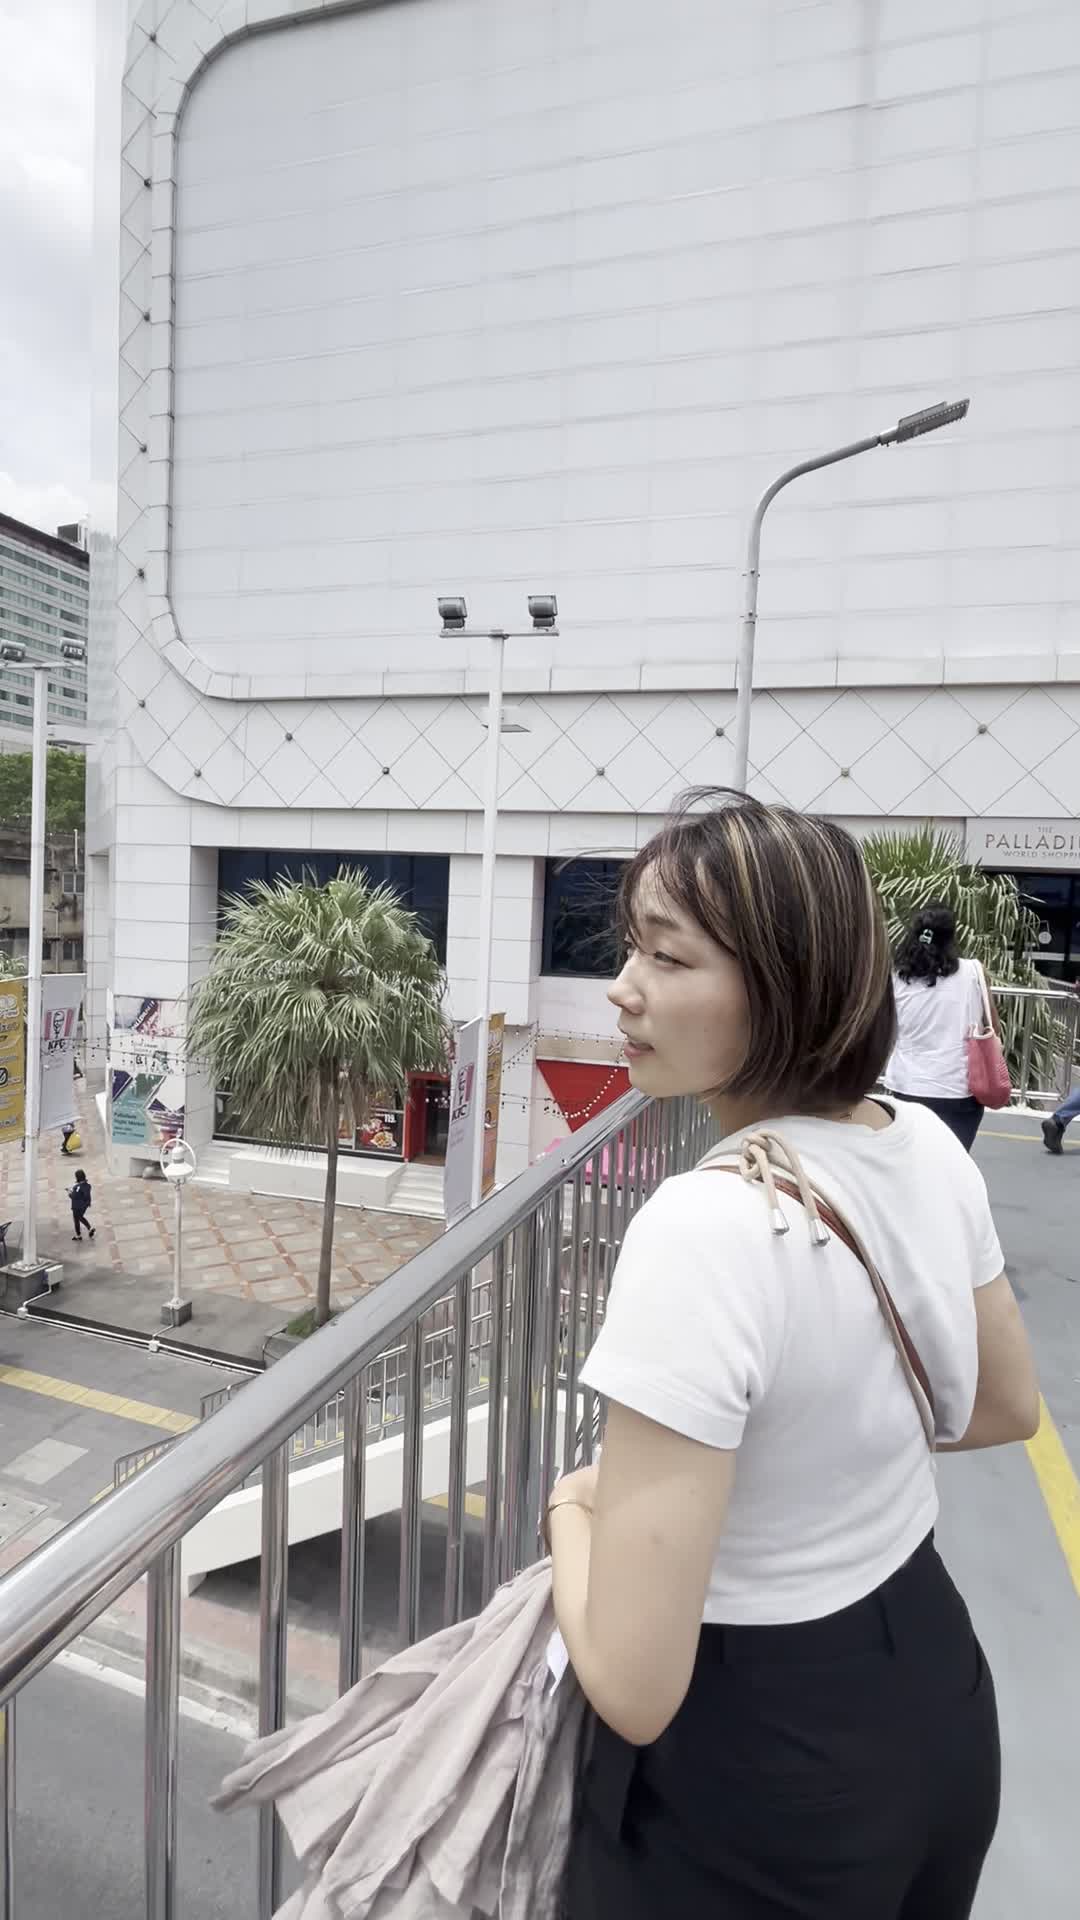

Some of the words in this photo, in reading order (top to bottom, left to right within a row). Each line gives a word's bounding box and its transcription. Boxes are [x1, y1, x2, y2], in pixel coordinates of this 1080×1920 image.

[985, 834, 1080, 850] PALLADI
[1004, 850, 1038, 858] WORLD
[48, 1038, 66, 1050] KFC
[452, 1104, 467, 1121] KFC
